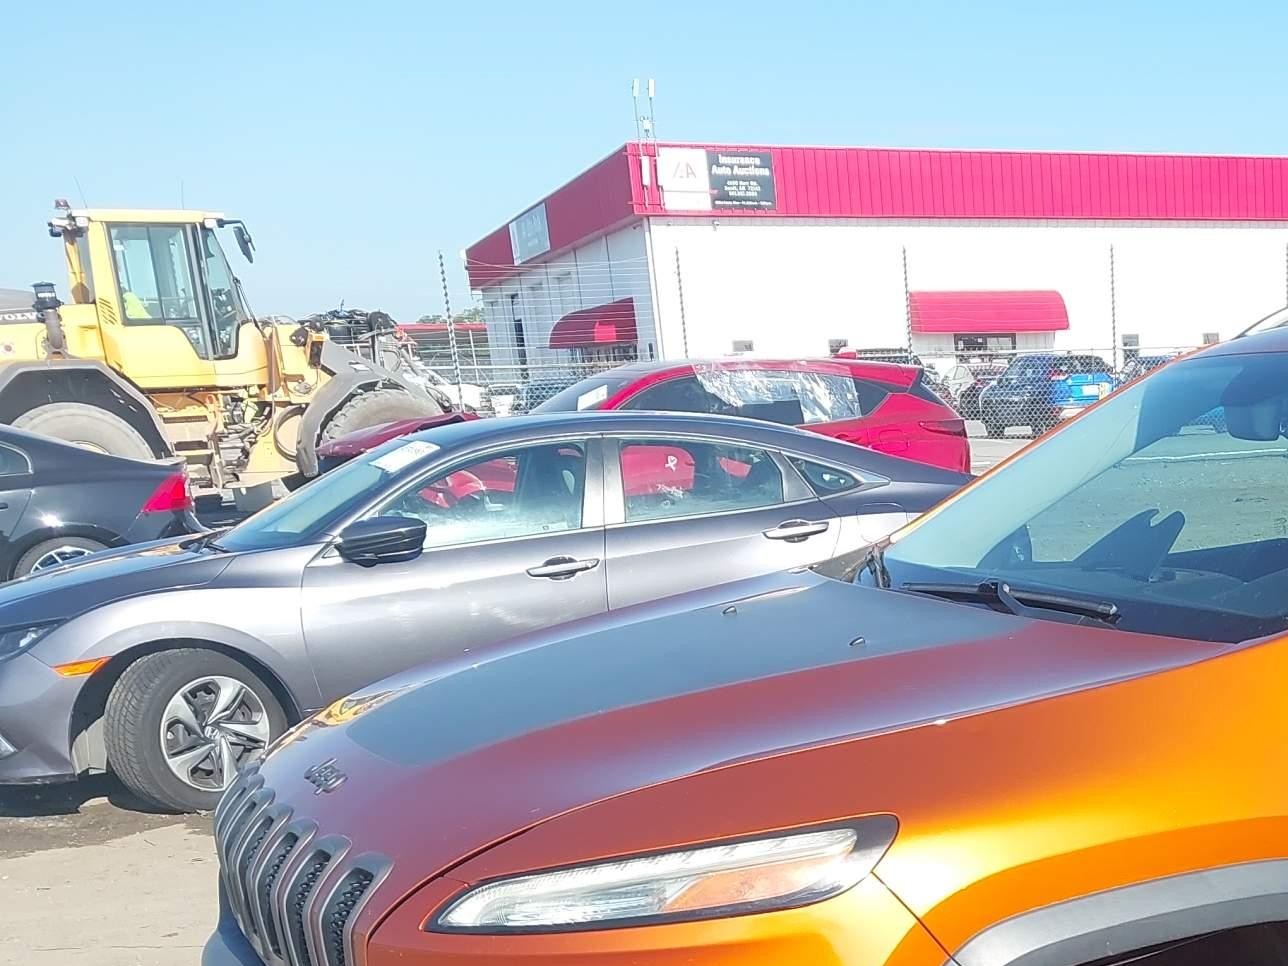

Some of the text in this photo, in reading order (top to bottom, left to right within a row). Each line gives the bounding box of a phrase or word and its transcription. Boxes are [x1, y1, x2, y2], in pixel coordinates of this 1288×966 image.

[711, 165, 770, 176] Auto Auctions
[0, 312, 37, 321] VOLV
